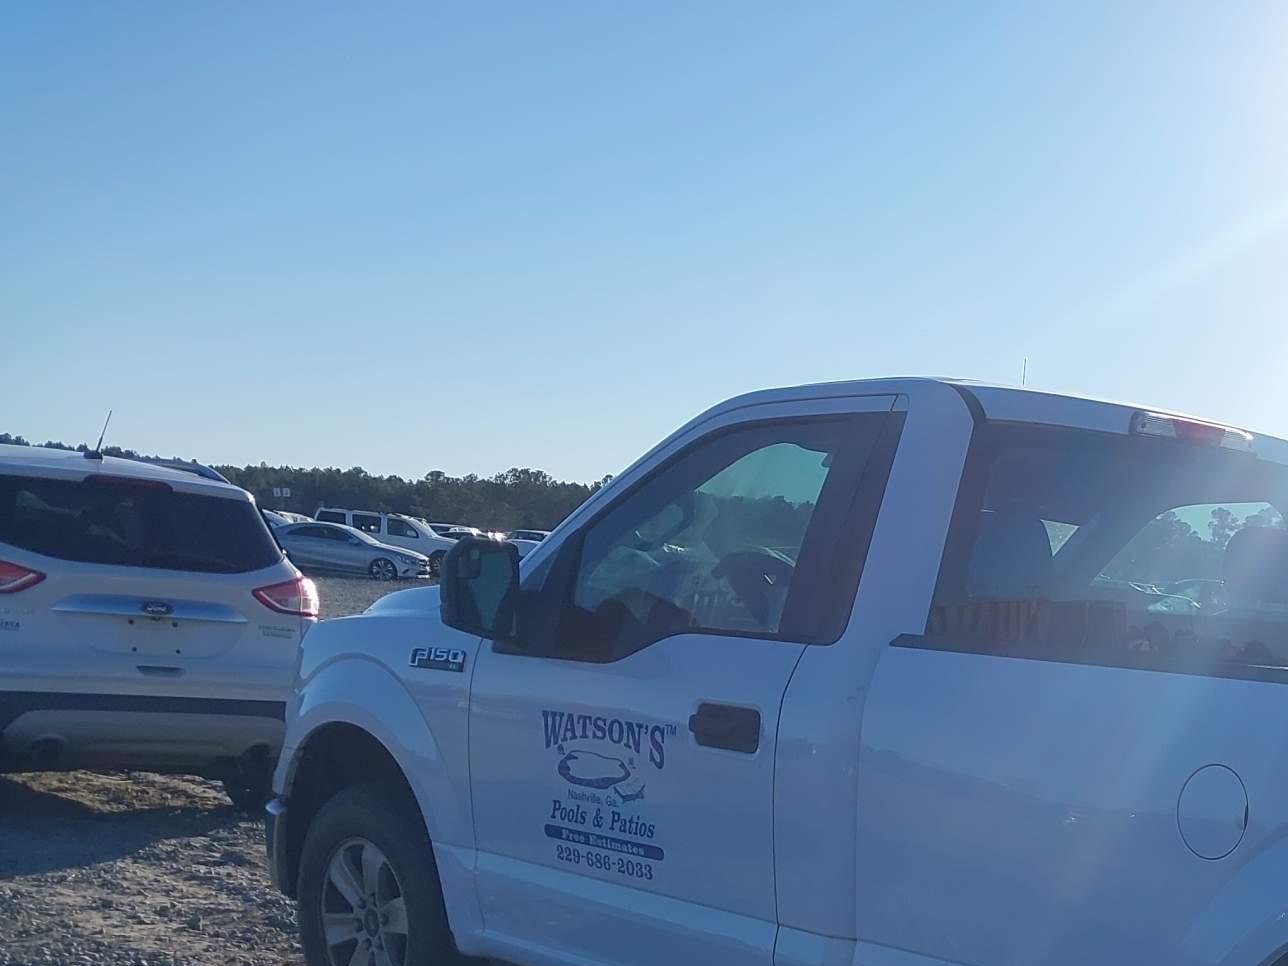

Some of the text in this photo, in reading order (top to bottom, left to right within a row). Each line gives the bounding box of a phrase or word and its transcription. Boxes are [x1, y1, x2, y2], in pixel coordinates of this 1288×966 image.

[542, 710, 665, 770] WATSON'S
[550, 799, 656, 839] Pools & Patios
[556, 844, 654, 880] 229-686-2033
[589, 833, 645, 856] Estimates
